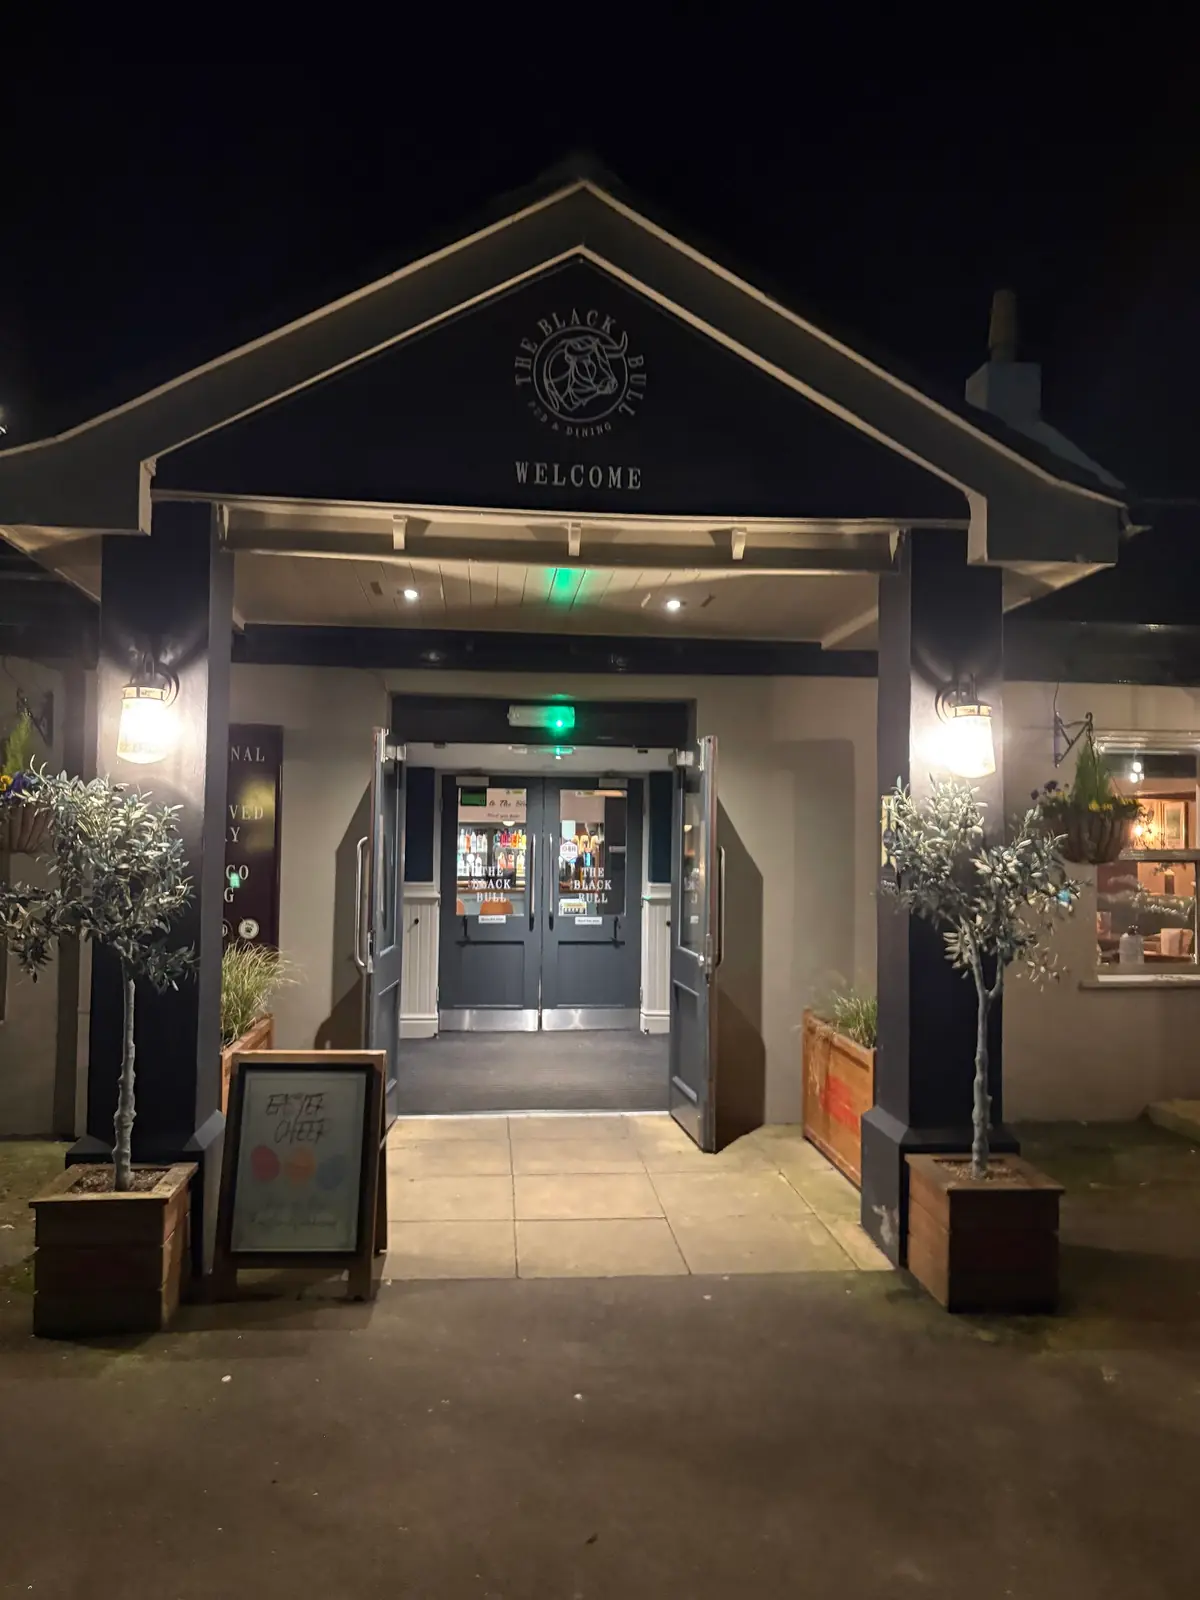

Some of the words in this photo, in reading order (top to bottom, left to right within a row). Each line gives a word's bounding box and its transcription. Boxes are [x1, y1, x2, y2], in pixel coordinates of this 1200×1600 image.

[514, 337, 538, 386] THE
[537, 308, 617, 336] BLACK
[618, 354, 647, 416] BULL
[566, 421, 612, 438] DINING
[515, 461, 642, 490] WELCOME
[230, 746, 265, 762] NAL
[229, 804, 264, 820] VED
[581, 867, 605, 878] THE
[573, 879, 612, 891] BLACK
[476, 892, 507, 903] BULL
